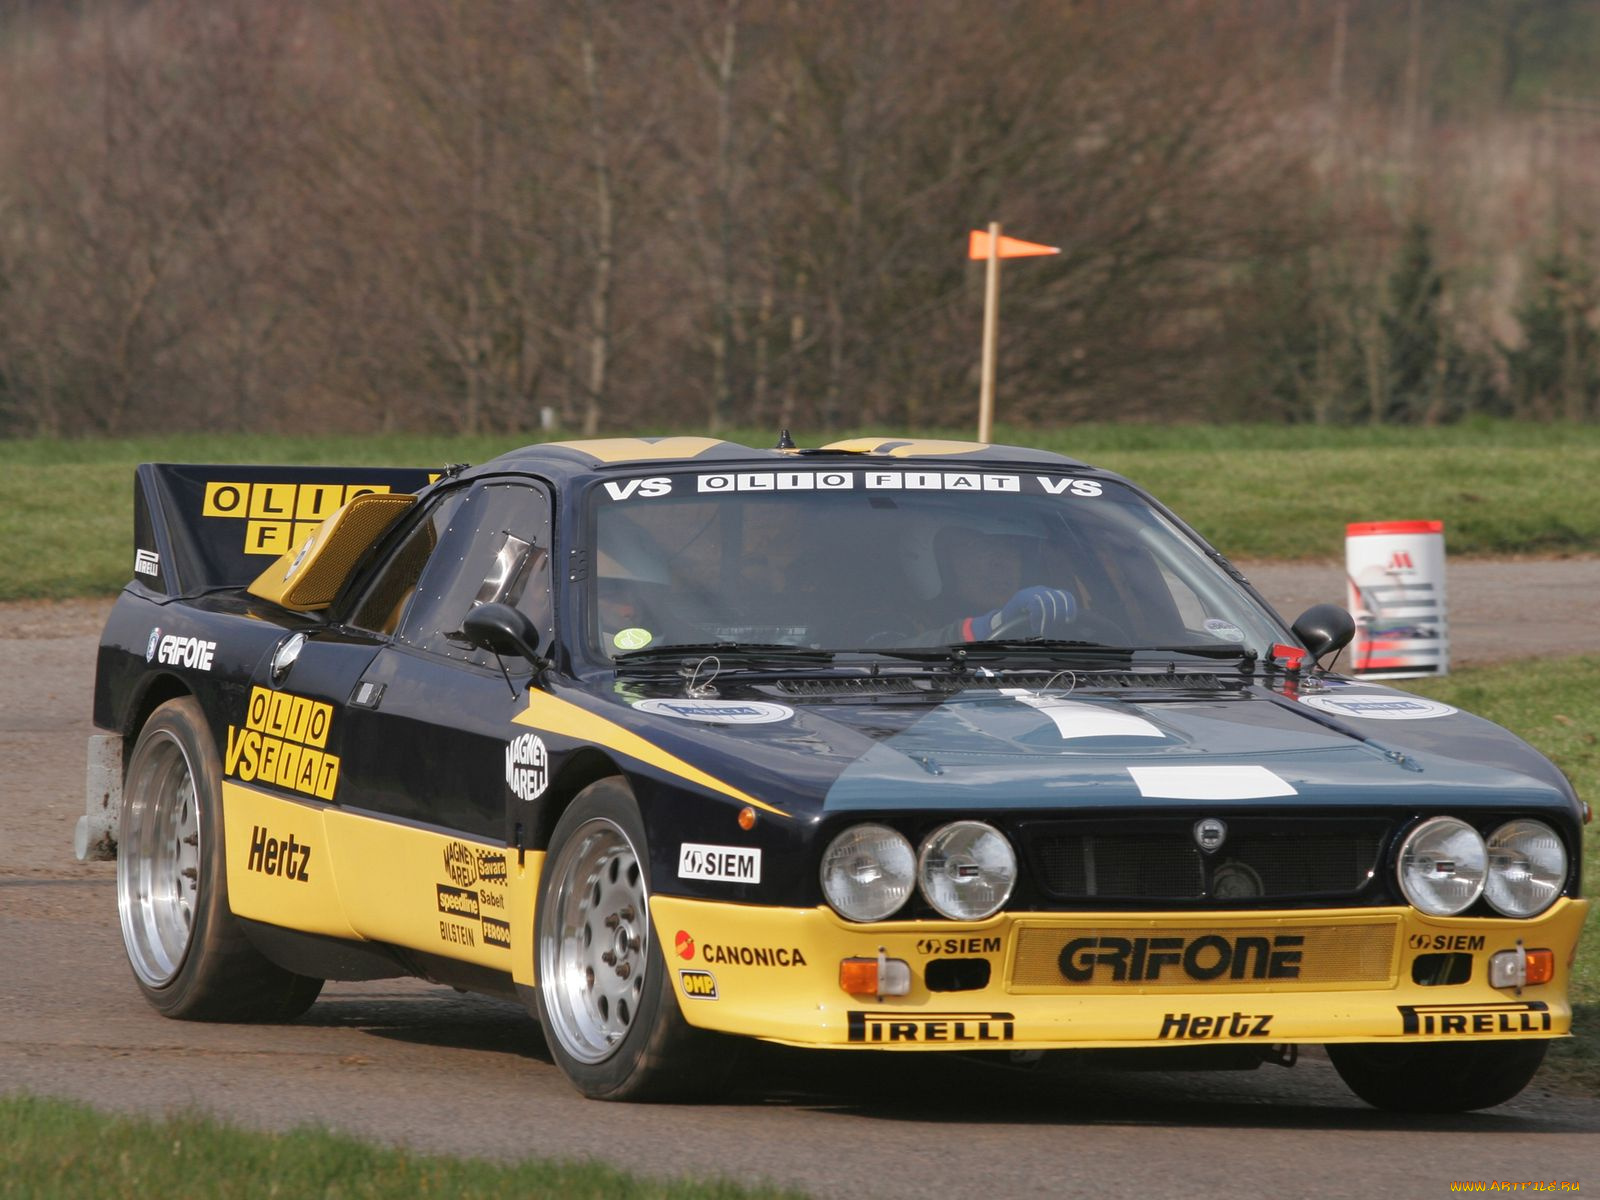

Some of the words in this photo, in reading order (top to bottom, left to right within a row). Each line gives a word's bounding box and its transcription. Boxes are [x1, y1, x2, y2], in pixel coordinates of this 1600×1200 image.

[603, 477, 673, 500] VS
[703, 473, 848, 491] OLIO
[875, 473, 1011, 490] FIAT
[1036, 476, 1103, 497] VS
[158, 634, 217, 671] GRIFONE
[252, 693, 326, 740] OLIO
[224, 724, 262, 782] VS
[262, 746, 335, 791] FIAT
[247, 825, 312, 882] Hertz
[704, 851, 755, 878] SIEM
[439, 920, 475, 947] BILSTEIN
[482, 921, 511, 944] FERODO
[944, 937, 1001, 954] SIEM
[1432, 935, 1486, 951] SIEM
[702, 943, 807, 967] CANONICA
[1057, 934, 1306, 983] GRIFONE
[847, 1010, 1016, 1043] PIRELLI
[1157, 1011, 1274, 1040] Hertz
[1396, 1001, 1552, 1035] PIRELLI
